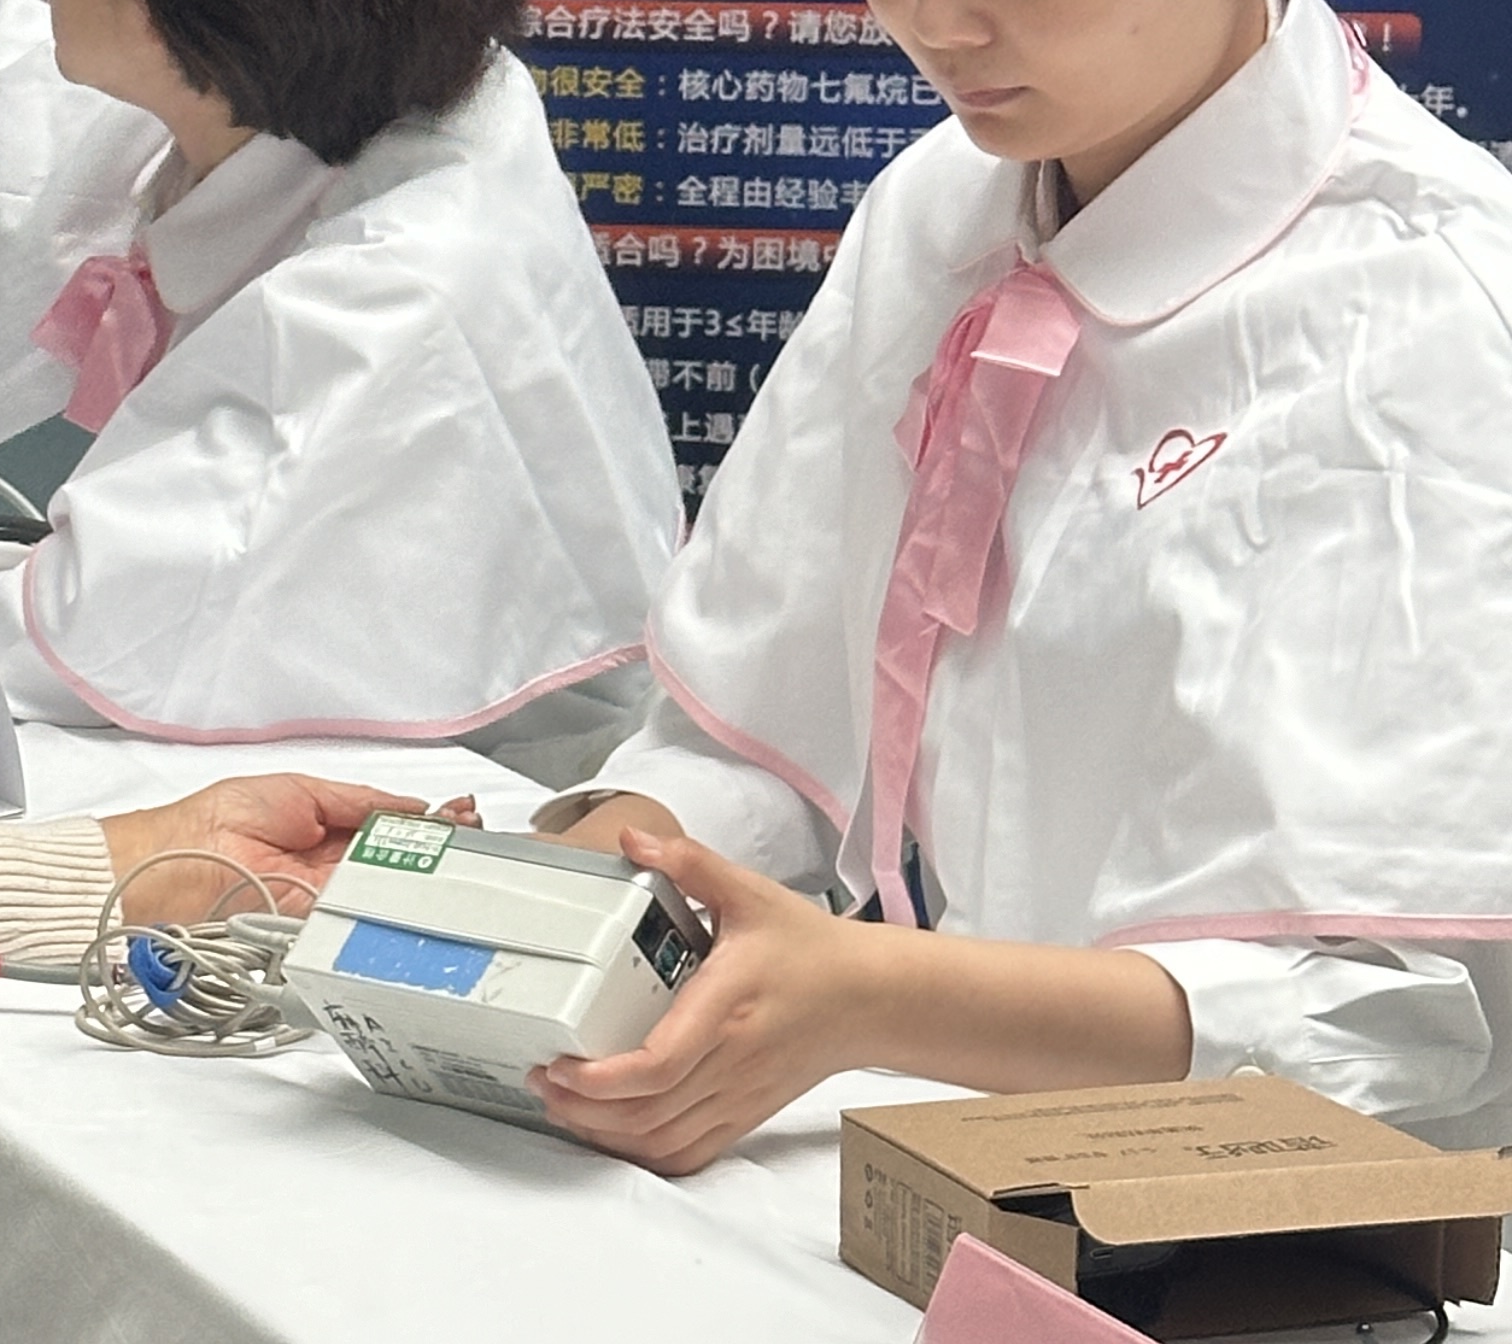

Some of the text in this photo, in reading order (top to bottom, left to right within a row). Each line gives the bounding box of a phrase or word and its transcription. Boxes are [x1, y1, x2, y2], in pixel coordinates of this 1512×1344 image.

[567, 172, 868, 210] 严密：全程由经验丰
